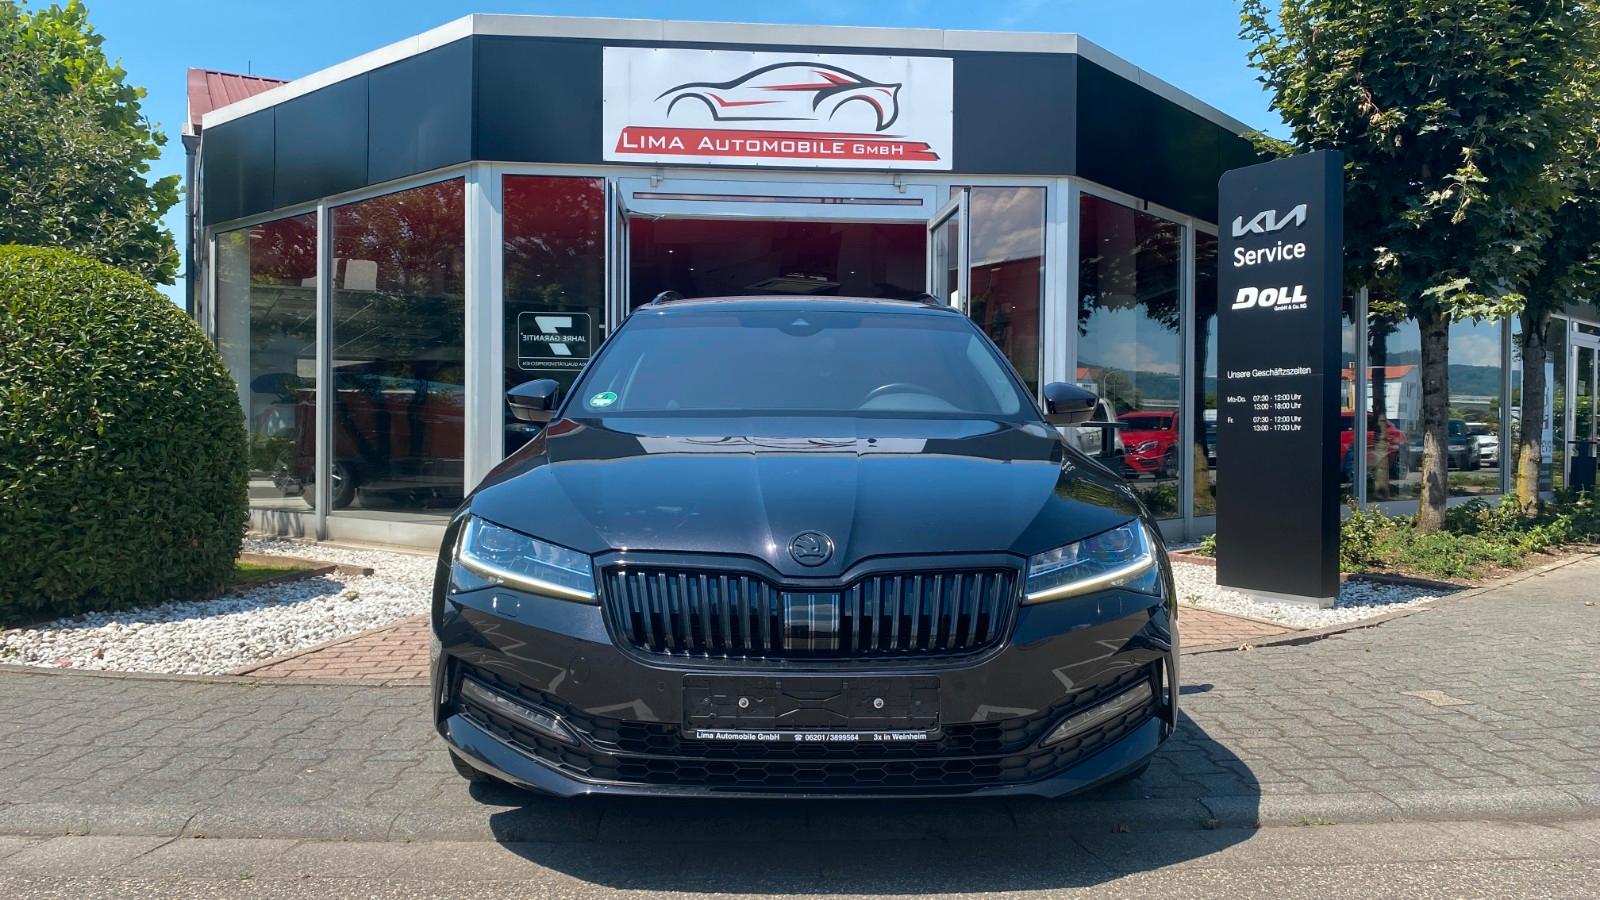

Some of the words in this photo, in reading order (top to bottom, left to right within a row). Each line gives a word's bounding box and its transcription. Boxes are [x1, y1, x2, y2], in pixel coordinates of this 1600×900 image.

[622, 132, 684, 150] LIMA
[697, 136, 845, 154] AUTOMOBILE
[1231, 204, 1307, 237] KIA
[1233, 240, 1306, 268] Service
[1231, 284, 1307, 310] DOLL
[1227, 370, 1251, 379] Unsere
[1252, 394, 1269, 402] 07:30
[1252, 424, 1269, 432] 13:00
[696, 731, 714, 740] Lima
[716, 732, 757, 741] Automobile
[757, 733, 780, 741] GmbH
[873, 733, 882, 741] 3x
[883, 733, 891, 741] in
[892, 732, 927, 740] Weinheim
